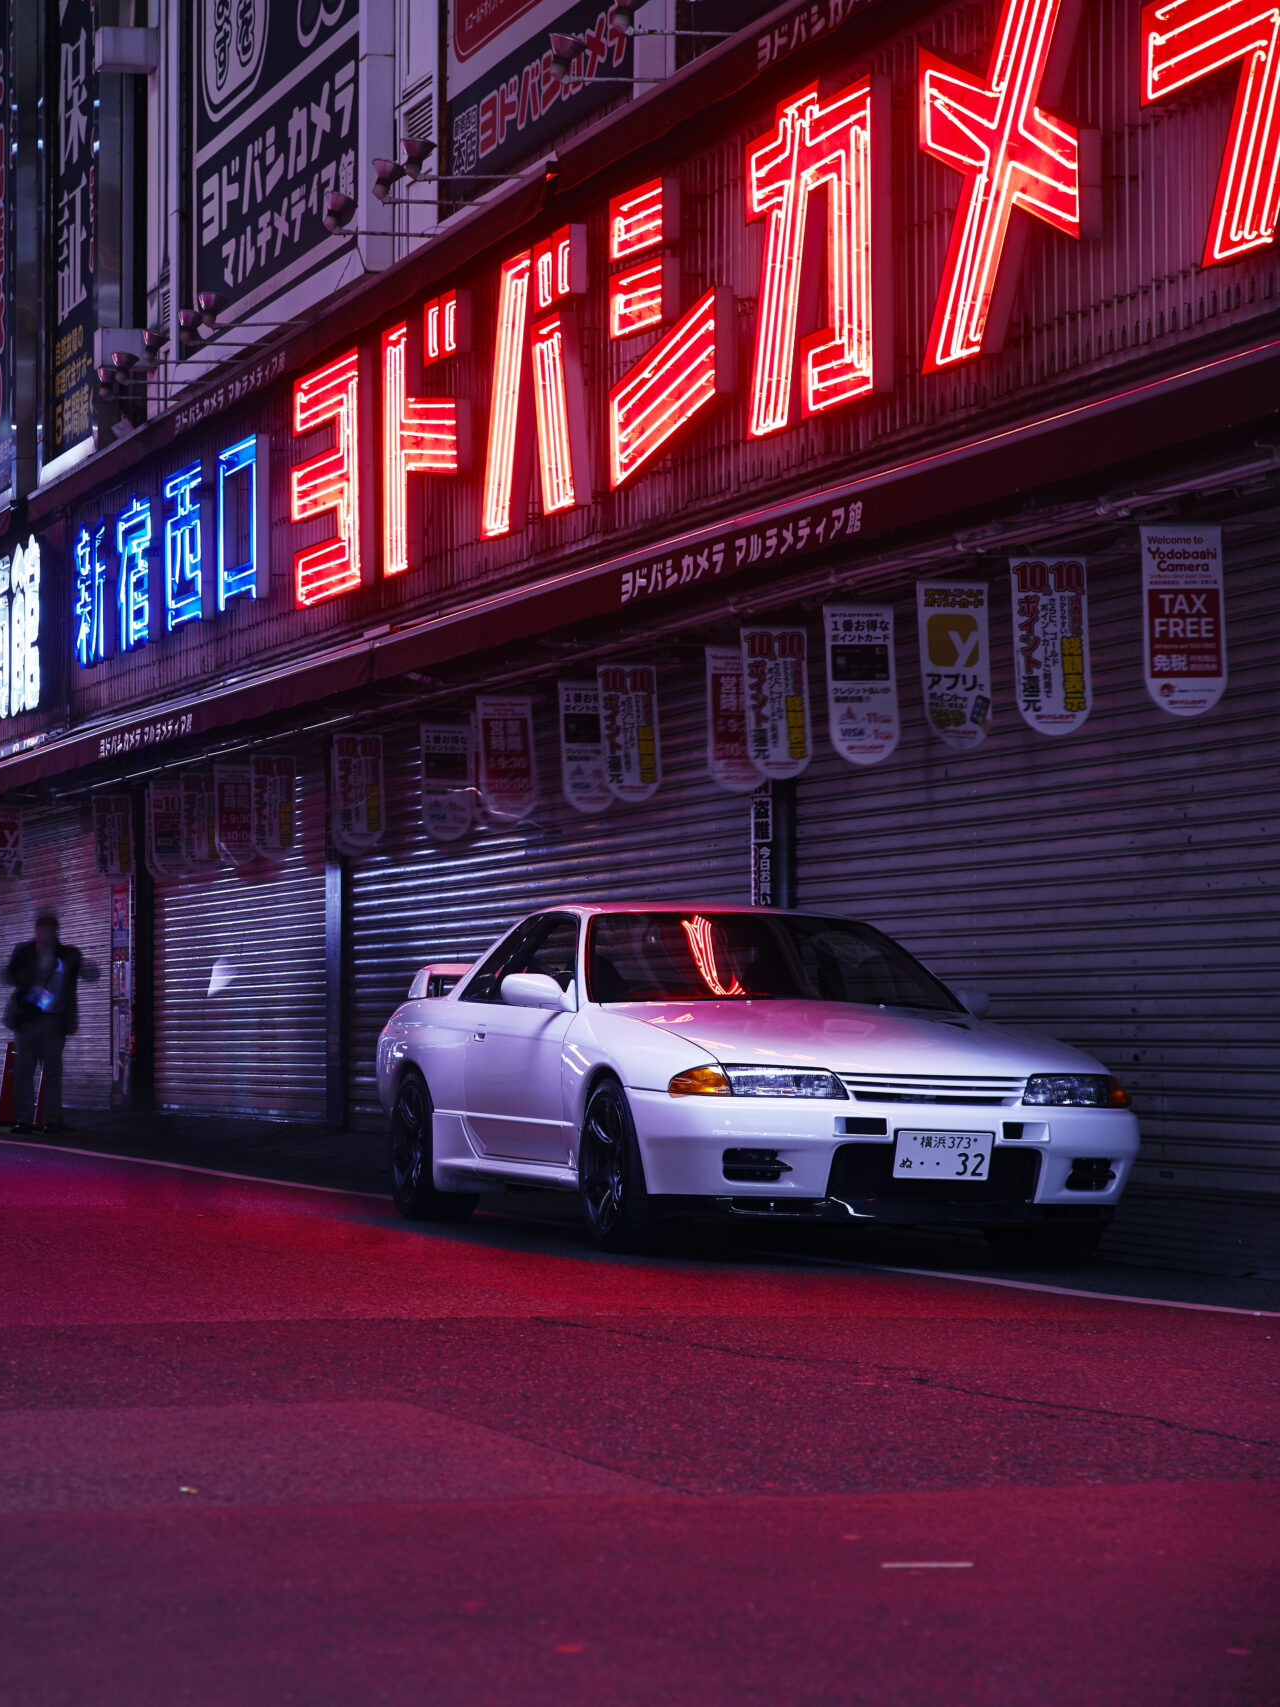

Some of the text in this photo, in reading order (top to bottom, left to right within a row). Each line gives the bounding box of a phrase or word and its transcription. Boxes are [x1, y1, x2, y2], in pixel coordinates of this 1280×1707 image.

[58, 0, 88, 327] 保証
[202, 59, 356, 247] ヨドバシカメラ
[221, 148, 356, 288] マルチメディア館
[291, 0, 1280, 609] ヨドバシカメラ
[173, 388, 224, 437] ヨドバシカメラ
[73, 433, 258, 668] 新宿西口
[620, 500, 863, 604] ヨドバシカメラ マルチメディア館
[1147, 535, 1204, 545] Welcome to
[1147, 547, 1217, 560] Yodobashi
[1156, 560, 1210, 572] Camera
[1159, 593, 1208, 615] TAX
[831, 633, 890, 643] ポイントカード
[1153, 617, 1215, 639] FREE
[1152, 653, 1189, 672] 免税
[97, 728, 142, 759] ヨドバシカメラ
[840, 727, 865, 738] VISA
[900, 1152, 985, 1177] ぬ 32
